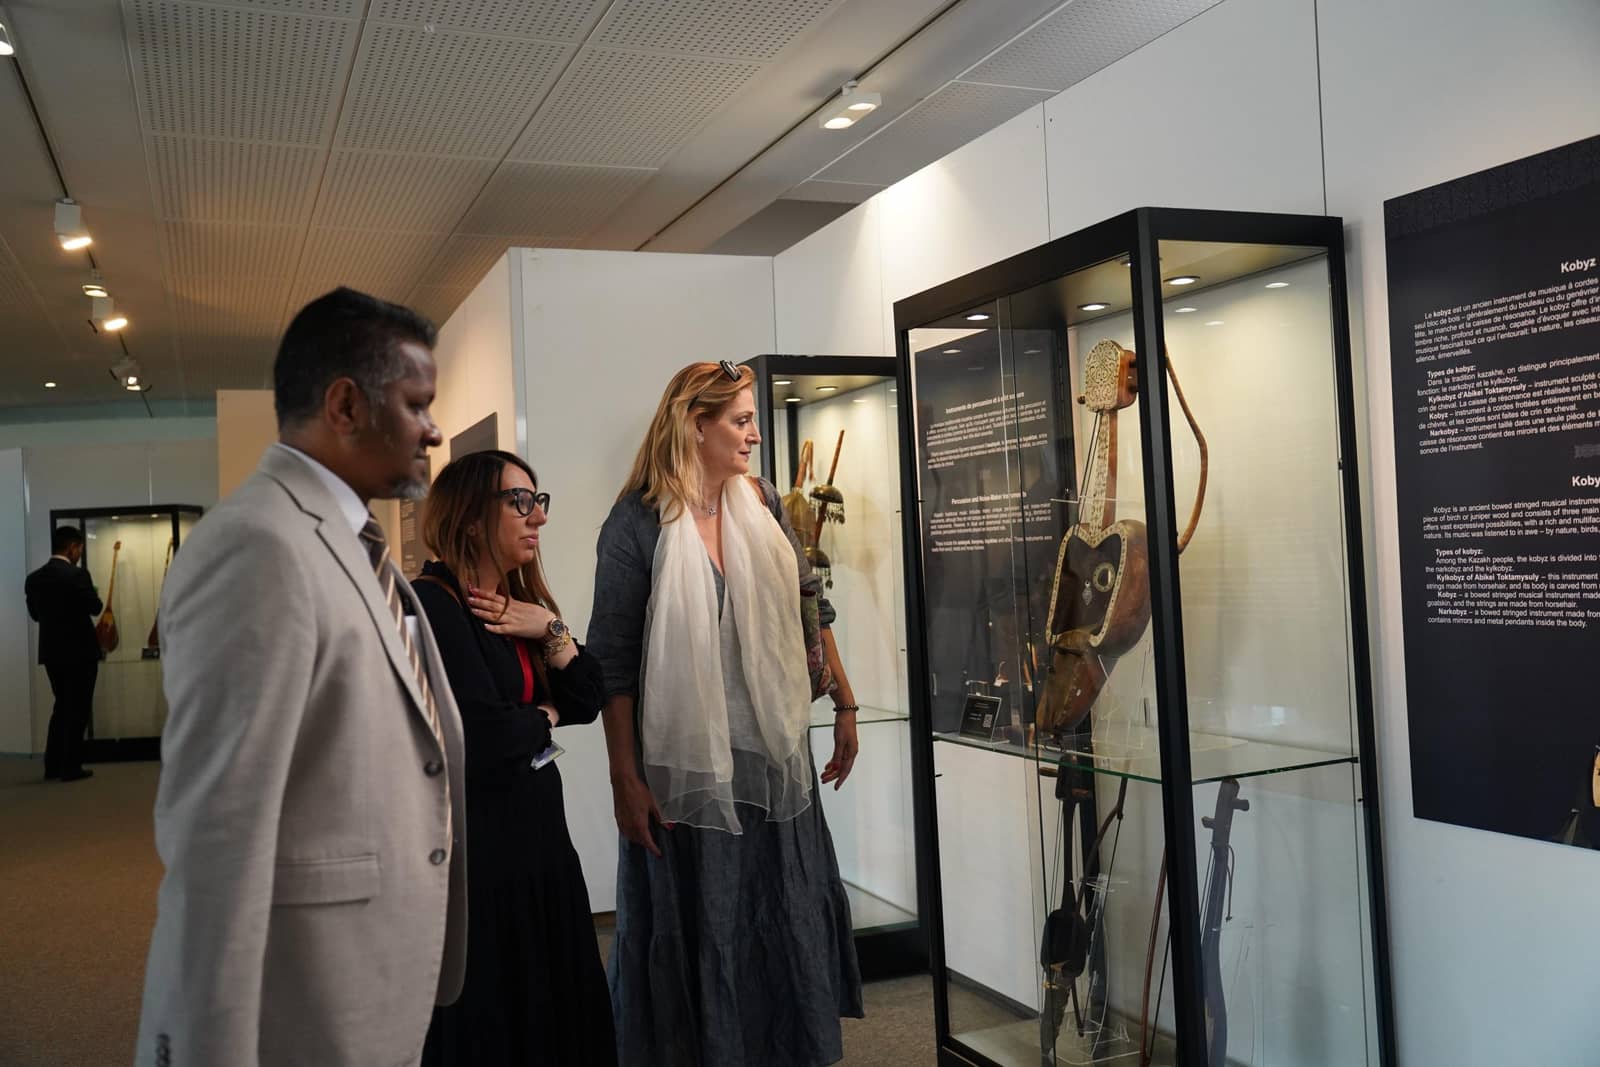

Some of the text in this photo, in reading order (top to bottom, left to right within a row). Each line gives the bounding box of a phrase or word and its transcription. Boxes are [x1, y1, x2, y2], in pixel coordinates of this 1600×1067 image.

[1560, 256, 1597, 274] Kobyz
[1427, 378, 1443, 386] Dans
[1451, 372, 1476, 383] tradition
[1517, 361, 1548, 374] distingue
[1549, 353, 1600, 369] principalement
[1427, 368, 1445, 379] Types
[1455, 364, 1476, 375] kobyz:
[1428, 393, 1456, 405] Kylkobyz
[1533, 376, 1569, 388] instrument
[1570, 372, 1595, 385] sculpté
[1497, 391, 1531, 402] résonance
[1543, 385, 1571, 396] réalisée
[1582, 382, 1597, 391] bois
[1429, 411, 1449, 422] Kobyz
[1454, 406, 1486, 417] instrument
[1465, 415, 1486, 424] cordes
[1553, 404, 1577, 413] cheval.
[1430, 427, 1458, 438] Narkobyz
[1546, 414, 1564, 423] seule
[1566, 412, 1585, 423] pièce
[1561, 421, 1593, 431] éléments
[1433, 506, 1452, 515] Kobyz
[1513, 501, 1540, 511] stringed
[1540, 499, 1568, 508] musical
[1469, 512, 1491, 522] juniper
[1524, 509, 1552, 517] consists
[1453, 522, 1484, 531] expressive
[1435, 549, 1454, 557] Types
[1462, 548, 1483, 557] kobyz:
[1435, 558, 1456, 566] Among
[1528, 556, 1548, 564] kobyz
[1531, 583, 1548, 591] body
[1491, 592, 1517, 600] stringed
[1476, 600, 1497, 608] strings
[1438, 608, 1467, 616] Narkobyz
[1502, 609, 1528, 618] stringed
[1504, 619, 1534, 627] pendants
[1568, 620, 1588, 629] body.
